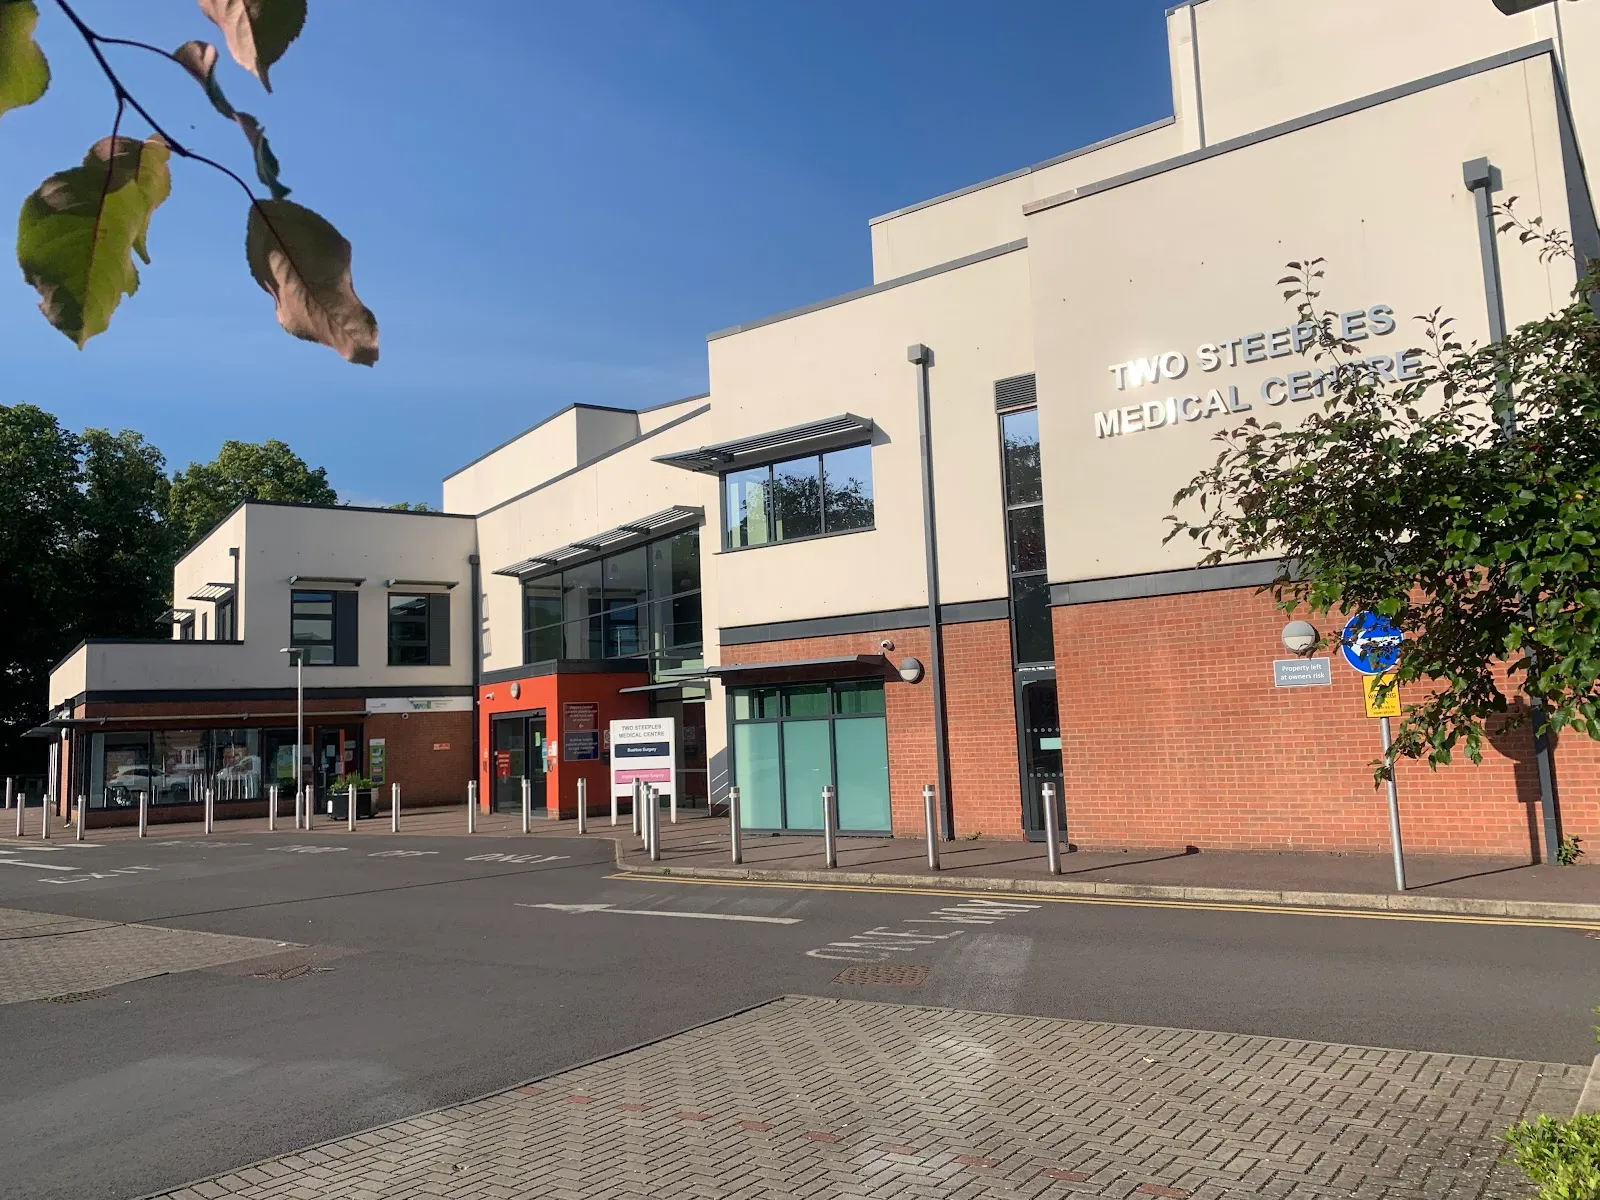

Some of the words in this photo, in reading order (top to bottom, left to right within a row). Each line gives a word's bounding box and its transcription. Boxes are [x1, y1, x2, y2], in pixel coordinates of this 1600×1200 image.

[1108, 350, 1188, 391] TWO
[1196, 304, 1396, 372] STEEPES
[1094, 385, 1252, 438] MEDICAL
[1281, 665, 1310, 673] Property
[37, 864, 160, 884] EXIT
[464, 853, 571, 864] ONLY
[804, 926, 966, 963] ONE
[902, 899, 1043, 925] WAY
